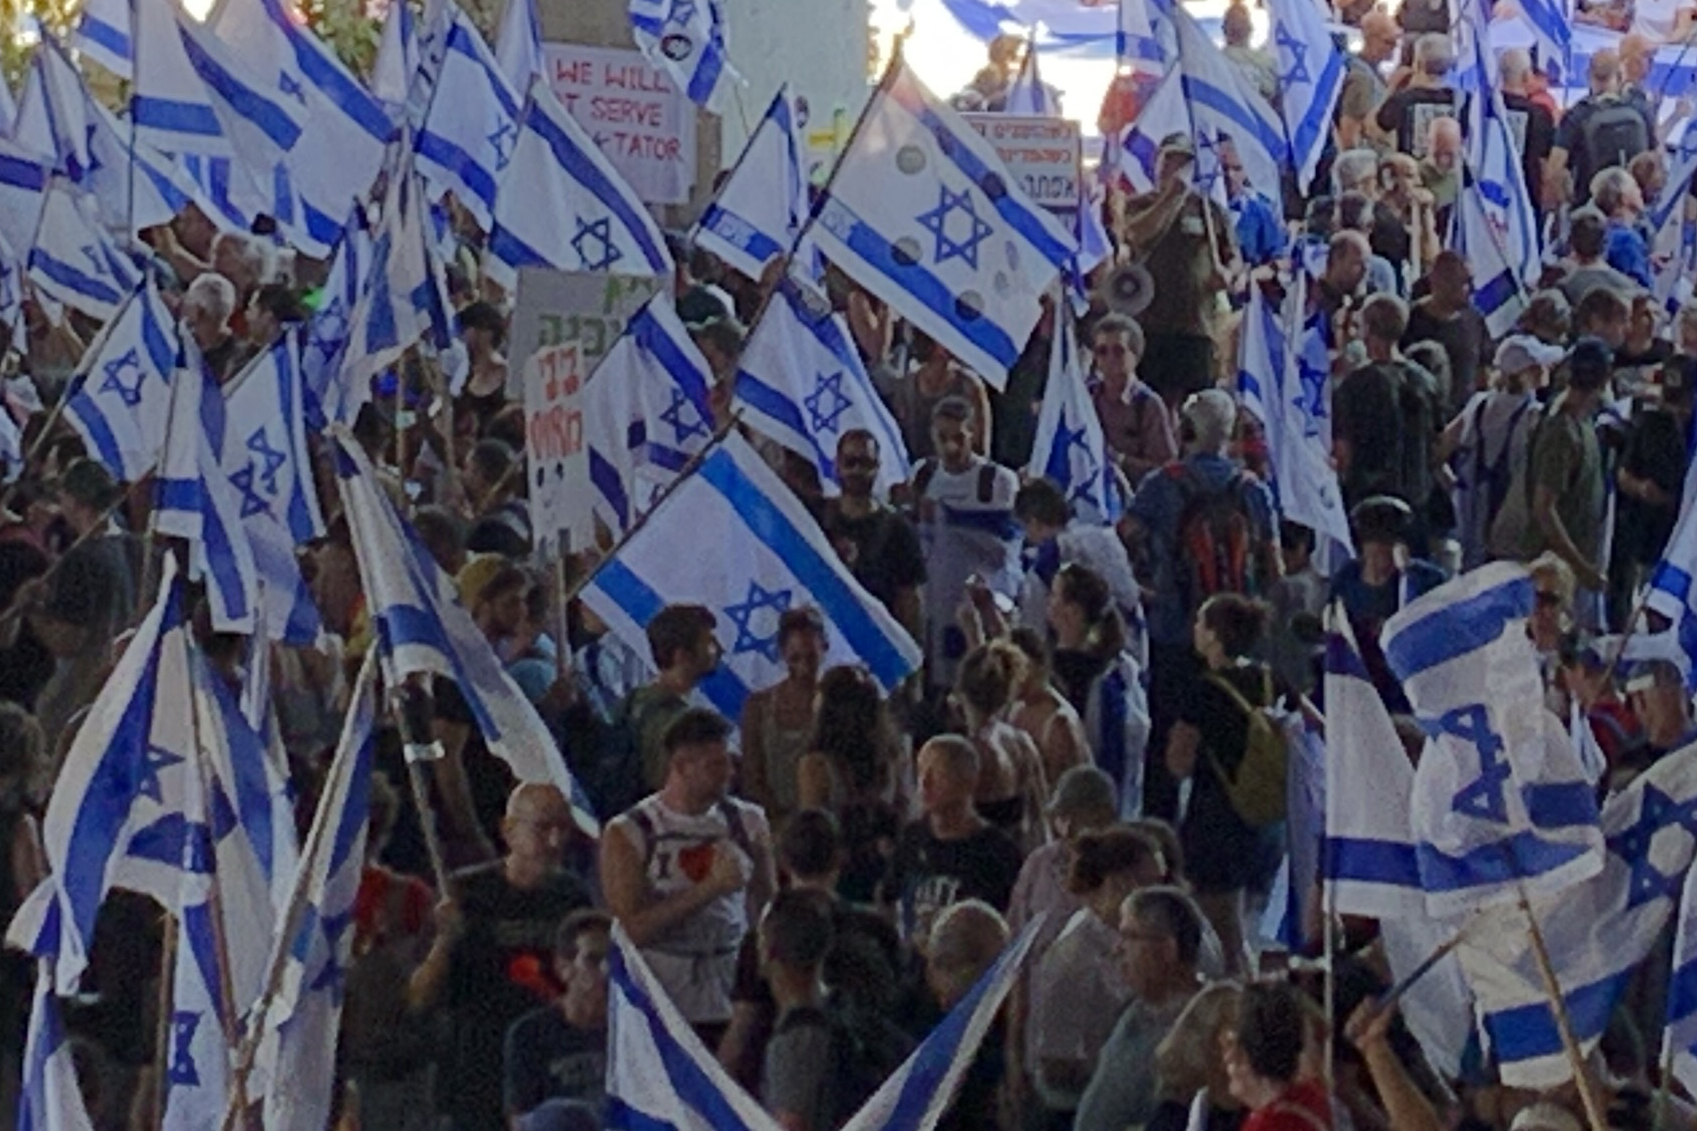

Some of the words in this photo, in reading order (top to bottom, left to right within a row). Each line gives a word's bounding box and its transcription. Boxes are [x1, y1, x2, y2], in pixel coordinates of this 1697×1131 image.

[556, 58, 593, 85] WE
[606, 65, 670, 93] WILL
[591, 98, 661, 127] SERVE
